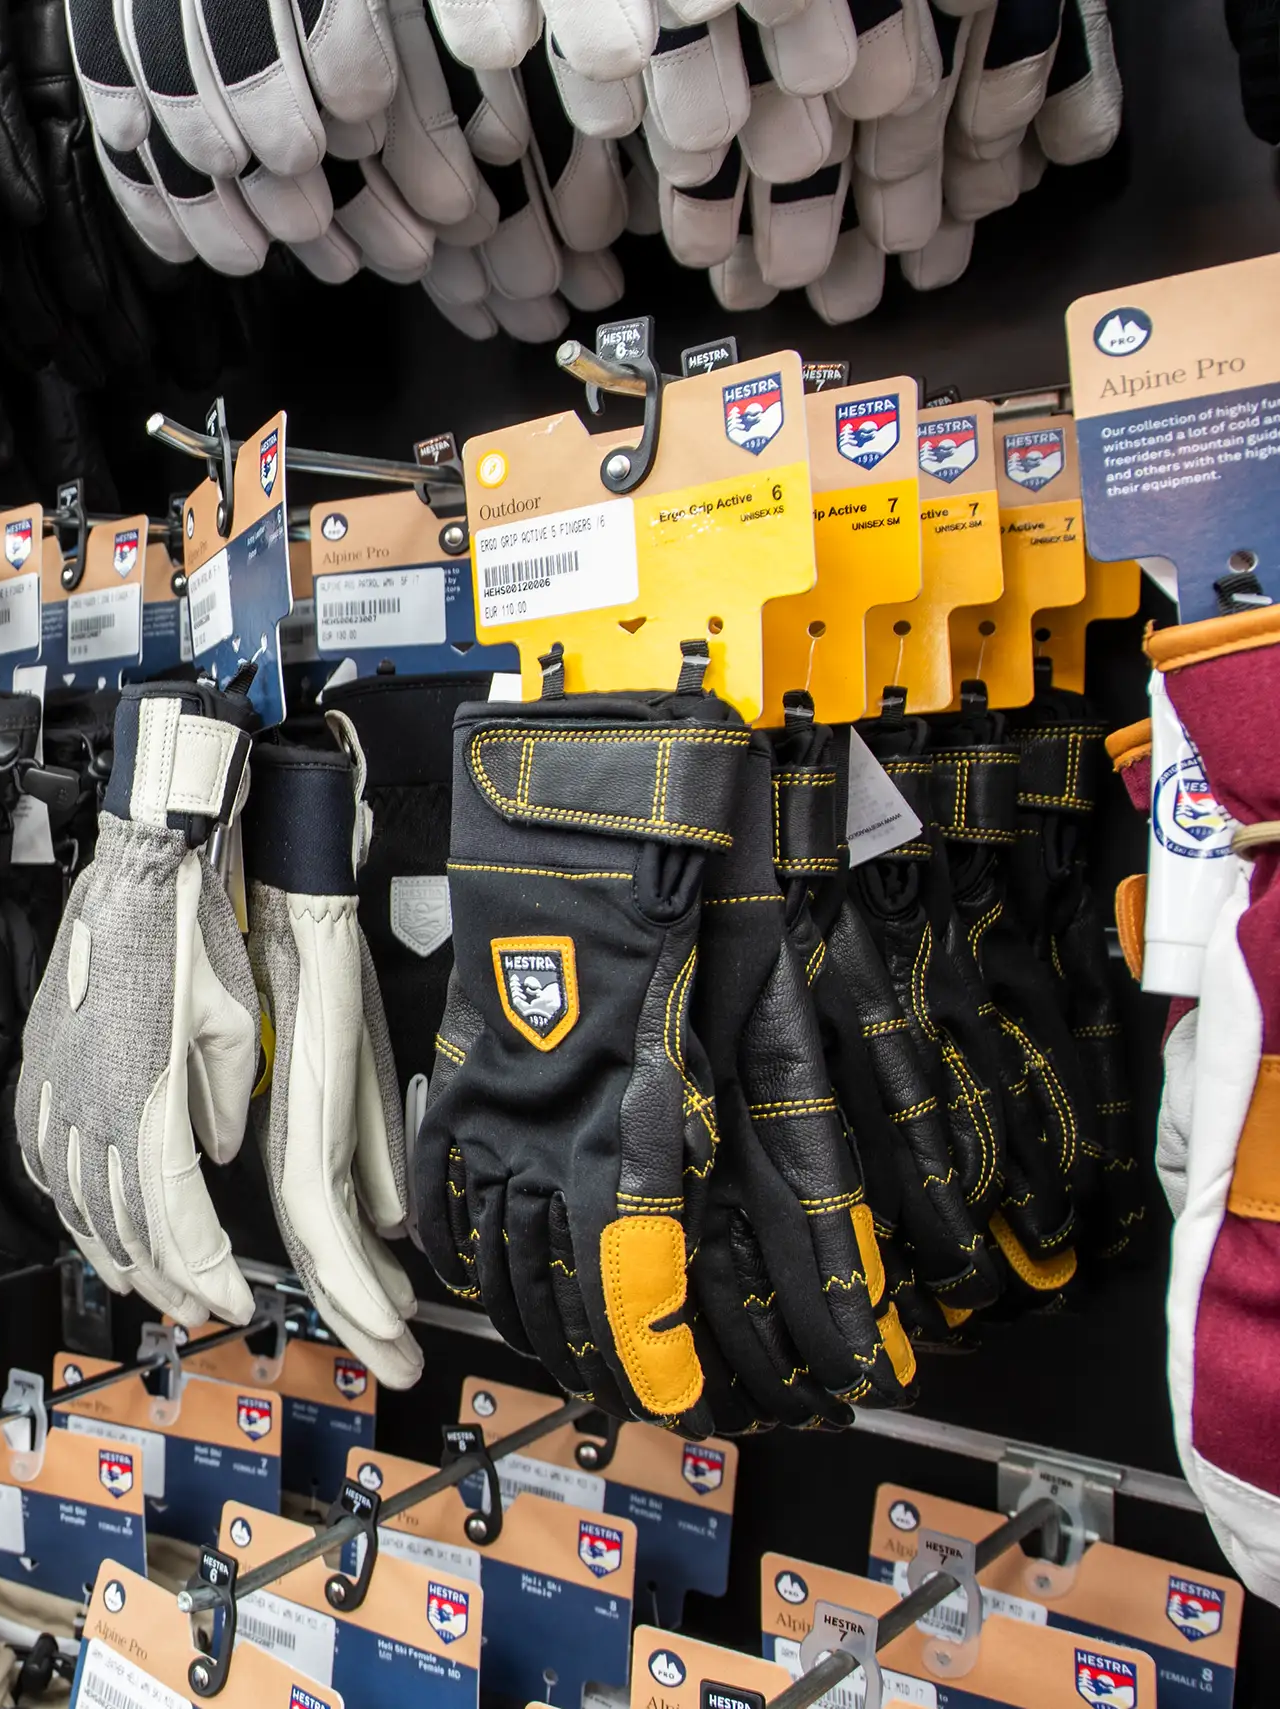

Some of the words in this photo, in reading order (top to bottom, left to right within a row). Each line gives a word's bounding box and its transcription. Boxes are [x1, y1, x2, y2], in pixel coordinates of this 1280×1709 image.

[603, 328, 641, 346] HESTRA
[1110, 335, 1136, 347] PRO
[615, 343, 626, 359] 6
[688, 348, 729, 368] HESTRA
[704, 362, 714, 373] 7
[802, 368, 842, 381] HESTRA
[816, 379, 825, 392] 7
[1099, 368, 1187, 399] Alpine
[1195, 357, 1246, 380] Pro
[724, 378, 780, 403] HESTRA
[838, 399, 896, 420] HESTRA
[926, 396, 952, 408] STRA
[917, 419, 974, 437] HESTRA
[1101, 426, 1126, 439] Our
[1128, 414, 1196, 435] collection
[1198, 408, 1214, 421] of
[1216, 402, 1259, 419] highly
[261, 433, 278, 452] HESTRA
[1006, 431, 1060, 448] HESTRA
[1103, 431, 1173, 453] withstand
[1176, 431, 1186, 440] a
[1188, 426, 1209, 439] lot
[1211, 422, 1226, 436] of
[1228, 416, 1260, 432] cold
[1263, 413, 1280, 425] an
[420, 440, 450, 458] HESTRA
[745, 437, 767, 449] 1936
[1179, 437, 1245, 456] mountain
[431, 451, 440, 464] 7
[857, 453, 880, 465] 1936
[1106, 469, 1132, 483] and
[1134, 461, 1181, 478] others
[1183, 456, 1215, 470] with
[1217, 451, 1242, 464] the
[1106, 484, 1140, 497] their
[1141, 470, 1223, 492] equipment.
[479, 496, 542, 521] Outdoor
[659, 509, 686, 523] Ergo
[689, 501, 714, 516] Grip
[716, 492, 753, 510] Active
[771, 484, 783, 501] 6
[828, 503, 868, 518] Active
[887, 497, 899, 513] 7
[920, 507, 949, 521] ctive
[969, 502, 980, 517] 7
[739, 507, 771, 523] UNISEX
[772, 504, 785, 516] XS
[7, 521, 31, 535] HESTRA
[851, 518, 885, 531] UNISEX
[887, 516, 901, 526] SM
[935, 521, 967, 534] UNISEX
[969, 519, 983, 529] SM
[1008, 522, 1046, 534] Active
[1064, 516, 1076, 532] 7
[115, 532, 138, 544] HESTRA
[480, 539, 498, 553] ERGO
[501, 533, 519, 549] GRIP
[521, 526, 548, 544] ACTIVE
[551, 526, 557, 539] 5
[559, 518, 592, 536] FINGERS
[595, 514, 606, 529] /6
[322, 549, 363, 566] Alpine
[366, 546, 390, 559] Pro
[483, 577, 552, 598] HEHS00120006
[484, 605, 499, 620] EUR
[501, 600, 528, 617] 110.00
[505, 955, 557, 971] HESTRA
[447, 1431, 476, 1442] HESTRA
[100, 1451, 131, 1465] HESTRA
[346, 1487, 372, 1509] HESTRA
[352, 1500, 361, 1514] 7
[125, 1517, 132, 1528] 7
[581, 1523, 621, 1542] HESTRA
[884, 1538, 918, 1558] Alpi
[925, 1540, 964, 1559] HESTRA
[203, 1554, 229, 1576] HESTRA
[939, 1554, 948, 1566] 7
[209, 1568, 218, 1584] 6
[429, 1583, 467, 1605] HESTRA
[1171, 1579, 1221, 1602] HESTRA
[776, 1612, 812, 1634] Alpi
[823, 1614, 866, 1636] HESTRA
[94, 1618, 127, 1649] Alpine
[128, 1637, 149, 1662] Pro
[838, 1629, 848, 1642] 7
[1077, 1651, 1133, 1677] HESTRA
[657, 1669, 675, 1680] PRO
[1160, 1669, 1198, 1689] FEMALE
[1199, 1680, 1213, 1693] LG
[1202, 1667, 1213, 1682] 8
[895, 1679, 911, 1694] MID
[293, 1688, 326, 1709] HESTRA
[709, 1693, 752, 1709] HESTRA
